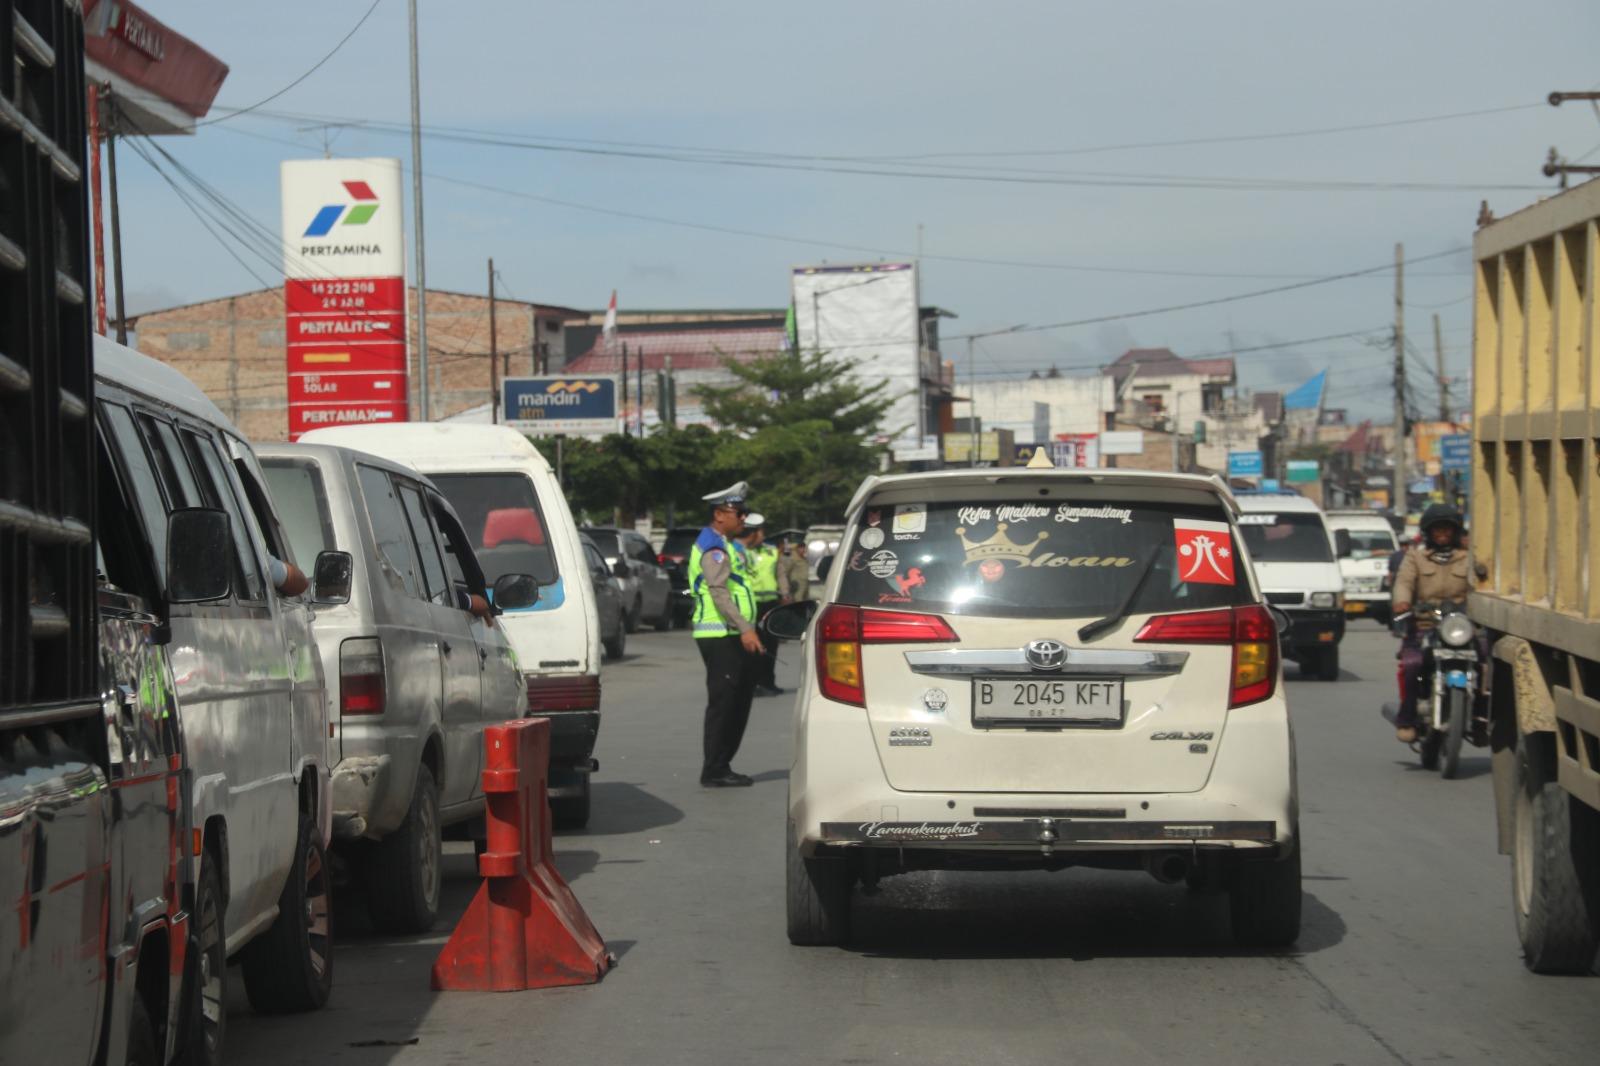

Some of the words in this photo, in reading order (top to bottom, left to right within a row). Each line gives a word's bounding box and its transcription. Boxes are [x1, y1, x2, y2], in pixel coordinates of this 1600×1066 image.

[301, 244, 382, 256] PERTAMINA
[299, 320, 373, 334] PERTALITE
[304, 383, 337, 393] SOLAR
[518, 389, 581, 406] mandiri
[302, 409, 376, 423] PERTAMAX
[518, 407, 545, 418] atm
[957, 507, 991, 526] Kefas
[995, 503, 1050, 522] Matthew
[981, 683, 993, 705] B
[1013, 683, 1065, 705] 2045
[1076, 683, 1114, 705] KFT
[1150, 731, 1214, 741] CALYA
